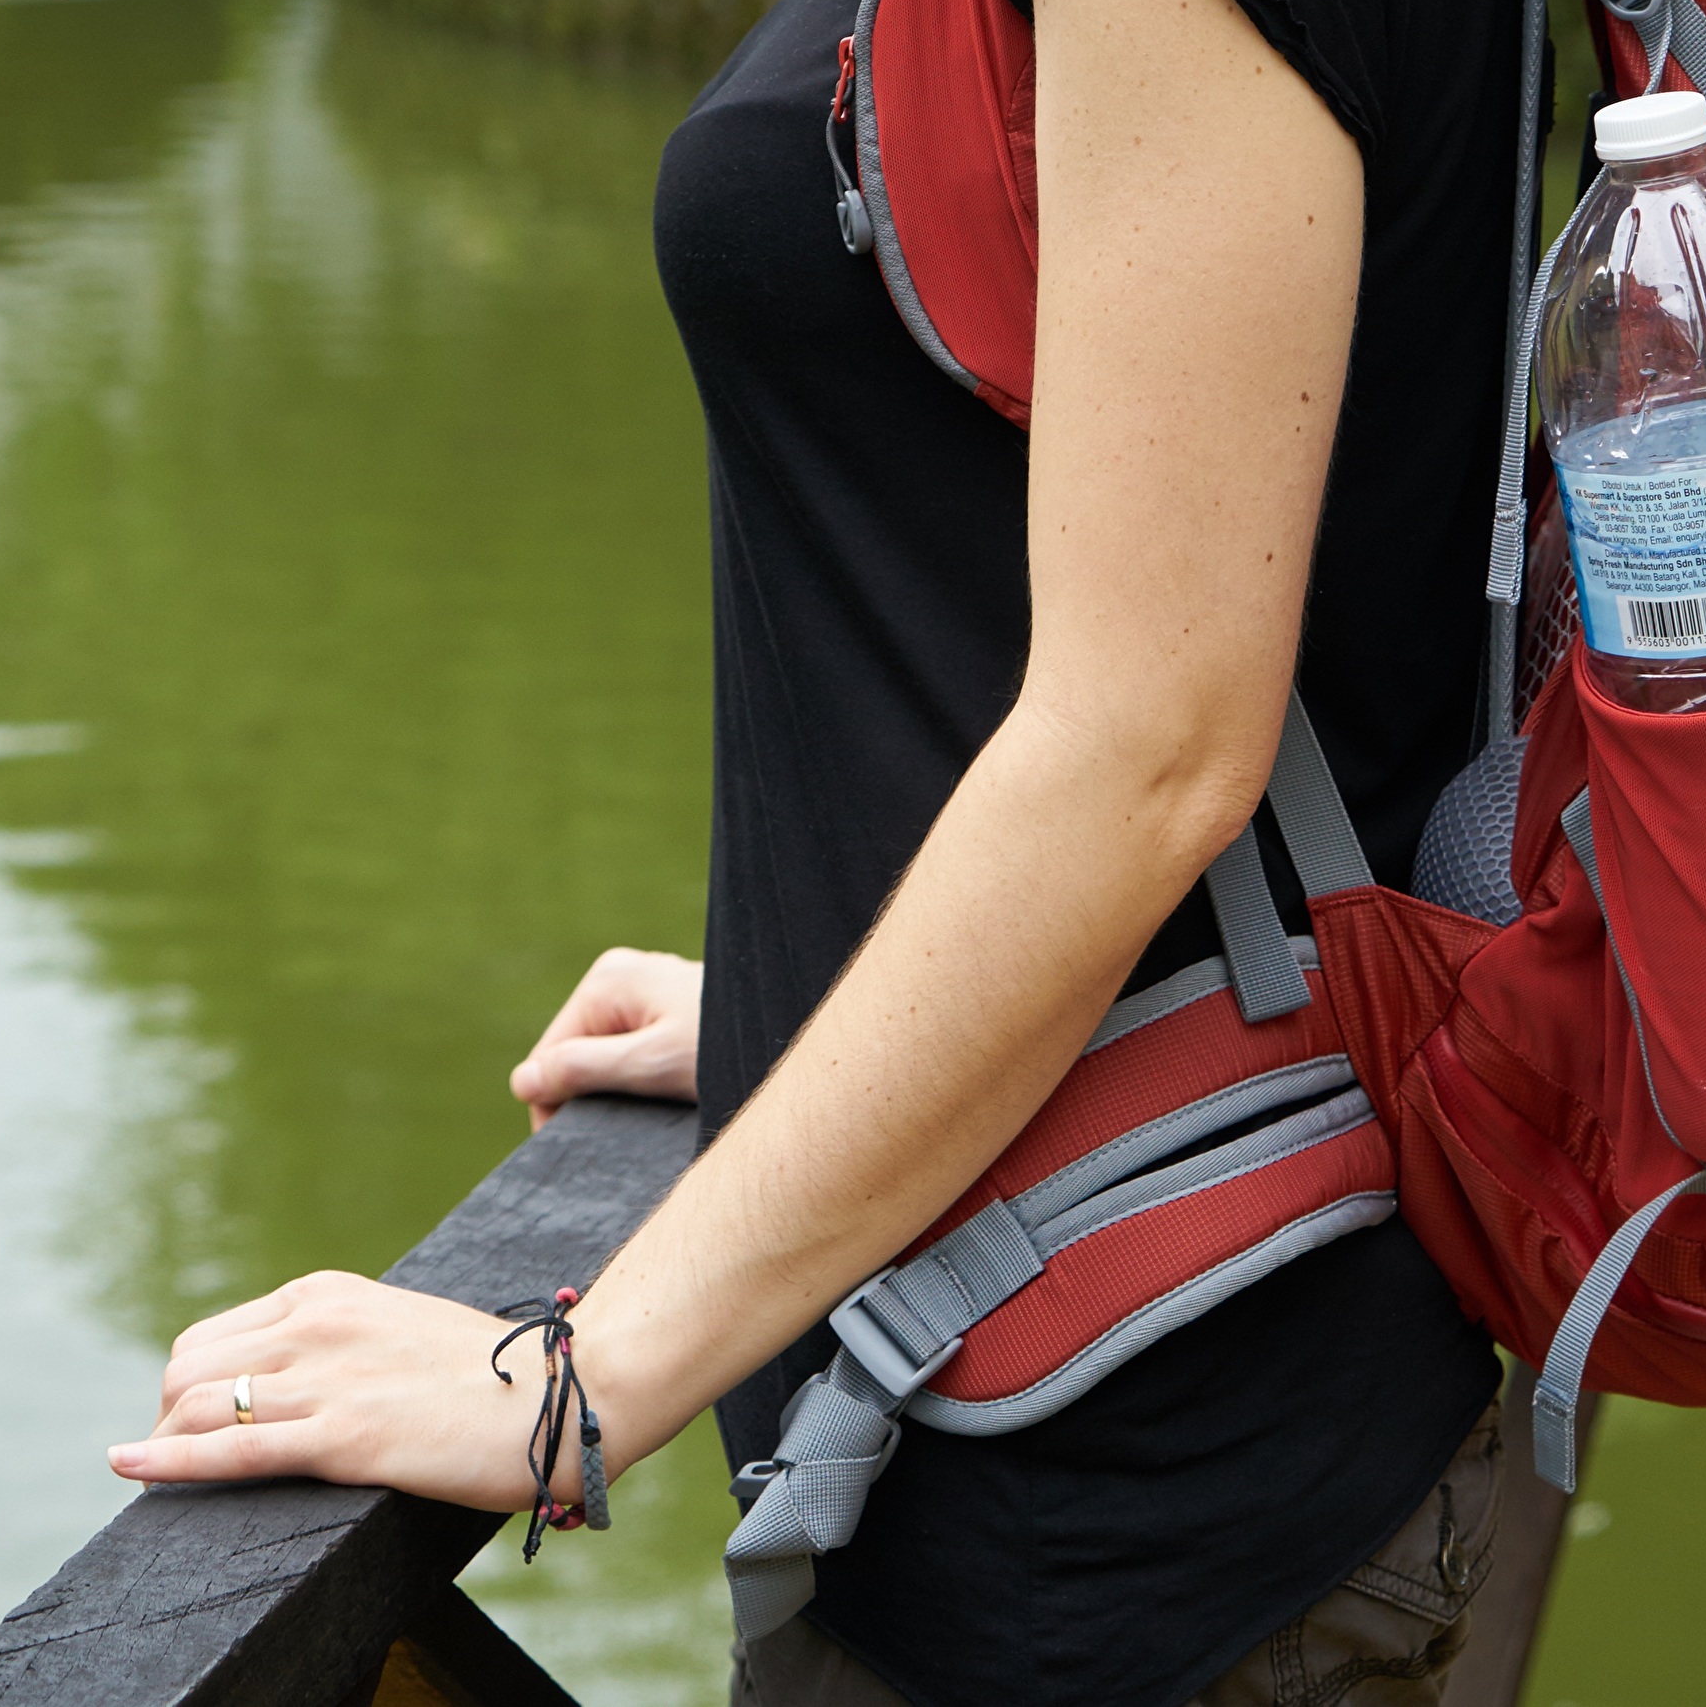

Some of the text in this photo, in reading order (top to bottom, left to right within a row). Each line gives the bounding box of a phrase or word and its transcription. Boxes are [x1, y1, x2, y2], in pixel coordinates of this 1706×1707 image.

[1602, 480, 1622, 490] Dibotol
[1623, 482, 1642, 491] Untuk
[1649, 479, 1676, 490] Bottled
[1679, 478, 1692, 487] For
[1575, 489, 1583, 498] KK
[1584, 490, 1615, 501] Supermart
[1617, 493, 1621, 501] &
[1623, 492, 1662, 502] Superstore
[1665, 491, 1682, 500] Sdn
[1685, 487, 1701, 497] Bhd
[1589, 502, 1609, 510] Wisma
[1635, 504, 1644, 512] 33
[1646, 504, 1651, 512] &
[1668, 501, 1689, 511] Jalan
[1595, 513, 1610, 522] Desa
[1638, 514, 1661, 524] 57100
[1663, 513, 1686, 523] Kuala
[1605, 524, 1629, 533] 03-9057
[1631, 526, 1647, 534] 3308
[1652, 525, 1665, 534] Fax
[1673, 520, 1705, 532] 03-9057
[1650, 535, 1673, 545] Email:
[1649, 547, 1701, 560] Manufactured
[1588, 556, 1604, 569] Spring
[1605, 560, 1622, 569] Fresh
[1624, 561, 1674, 571] Manufacturing
[1677, 560, 1693, 569] Sdn
[1611, 571, 1615, 579] &
[1632, 572, 1652, 581] Mukim
[1654, 573, 1680, 582] Batang
[1635, 583, 1653, 592] 44300
[1627, 636, 1632, 645] 9
[1638, 637, 1671, 647] 555603
